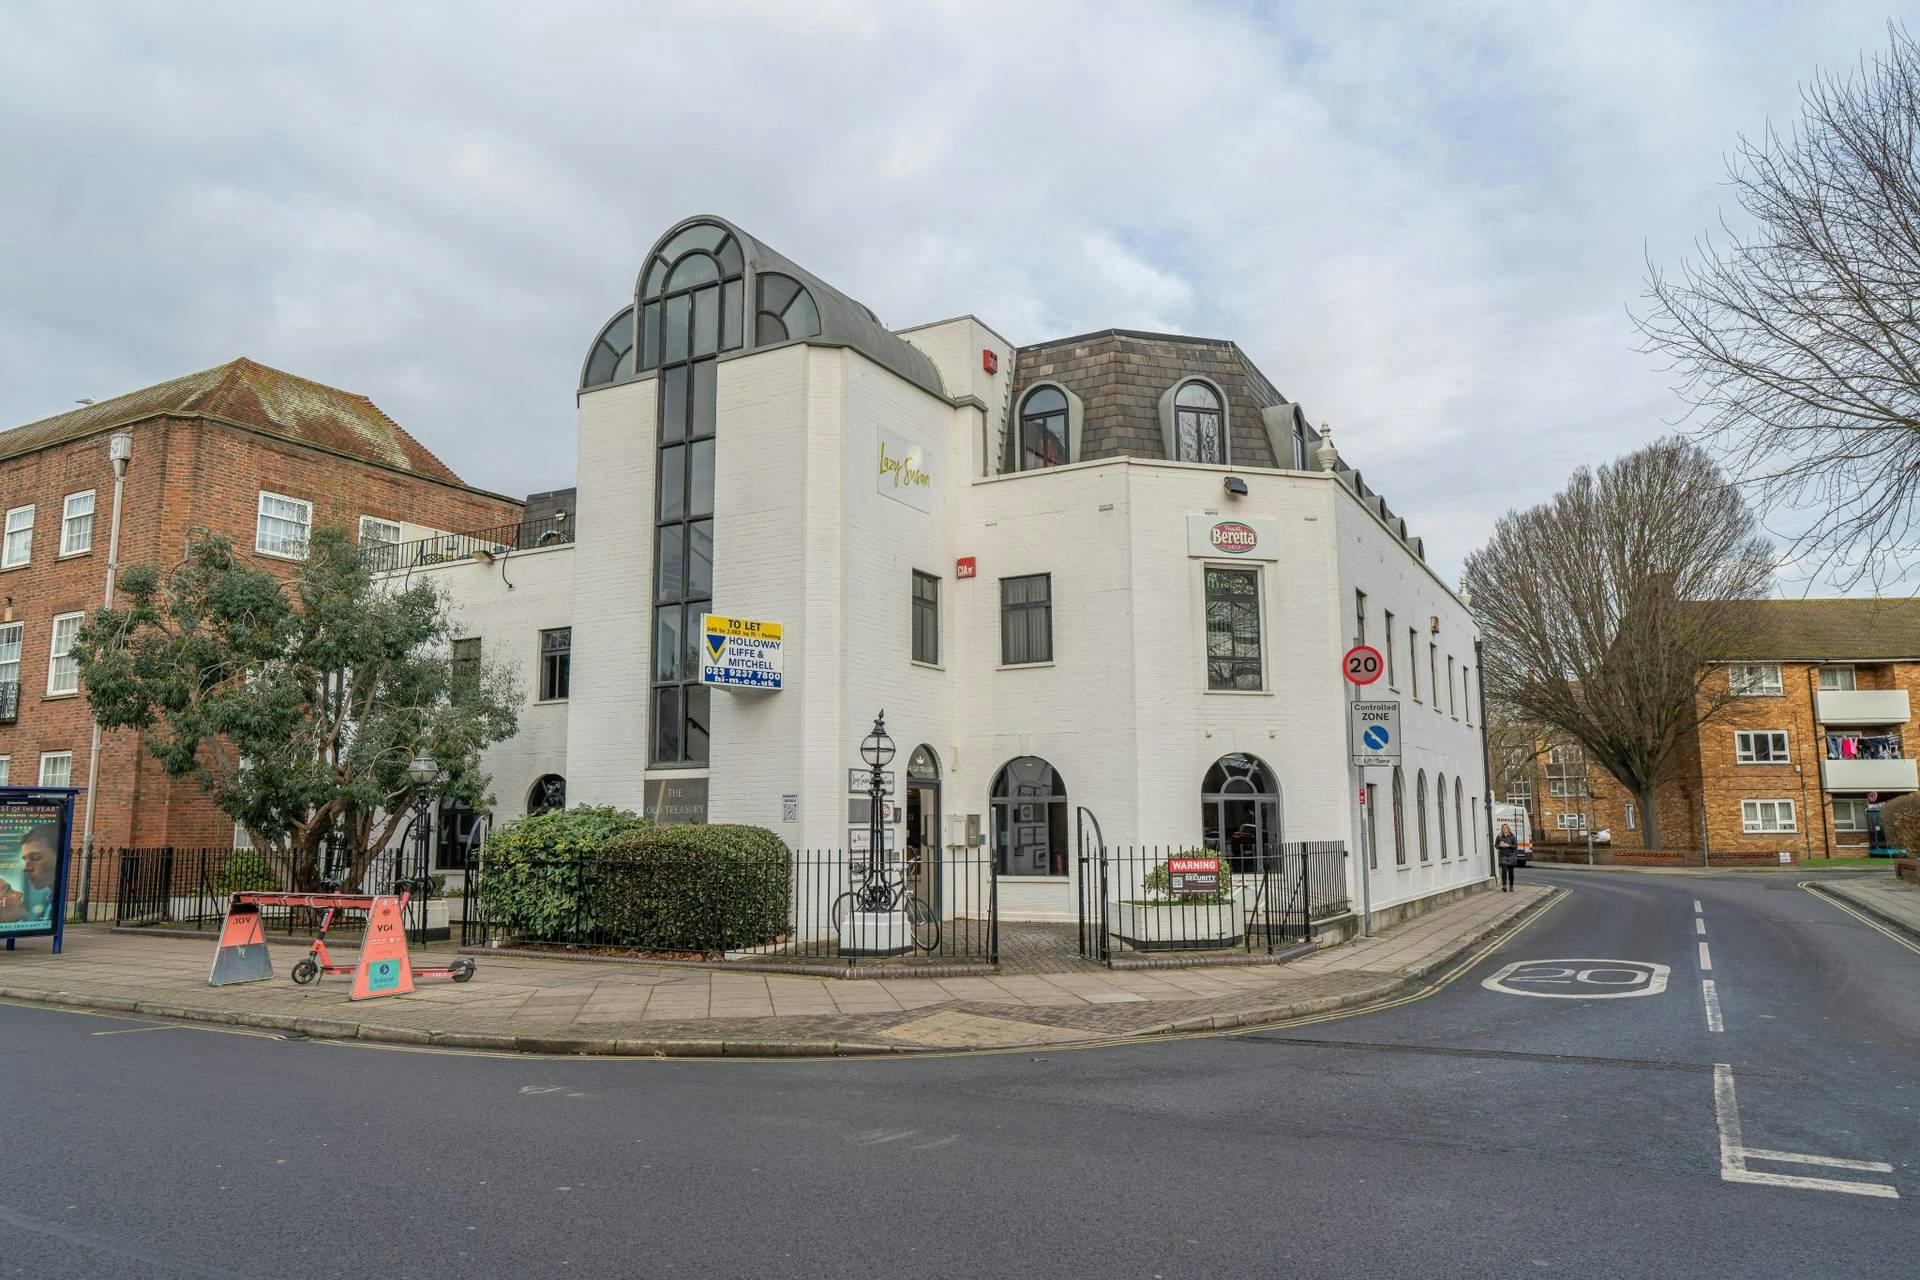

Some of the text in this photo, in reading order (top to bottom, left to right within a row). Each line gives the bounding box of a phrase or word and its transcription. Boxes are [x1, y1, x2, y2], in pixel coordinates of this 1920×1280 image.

[1212, 528, 1255, 545] Beretta
[728, 619, 761, 631] TO LET
[728, 636, 782, 650] HOLLOWAY
[728, 647, 764, 658] ILIFFE &
[728, 658, 774, 670] MITCHELL
[1350, 657, 1377, 673] 20
[706, 667, 781, 680] 023 9237 7800
[714, 675, 775, 687] hi-m.co.uk
[1354, 703, 1397, 711] Controlled
[1362, 713, 1389, 721] ZONE
[667, 788, 684, 798] THE
[665, 804, 704, 815] TREASURY
[1173, 861, 1216, 870] WARNING
[1506, 967, 1649, 985] 20
